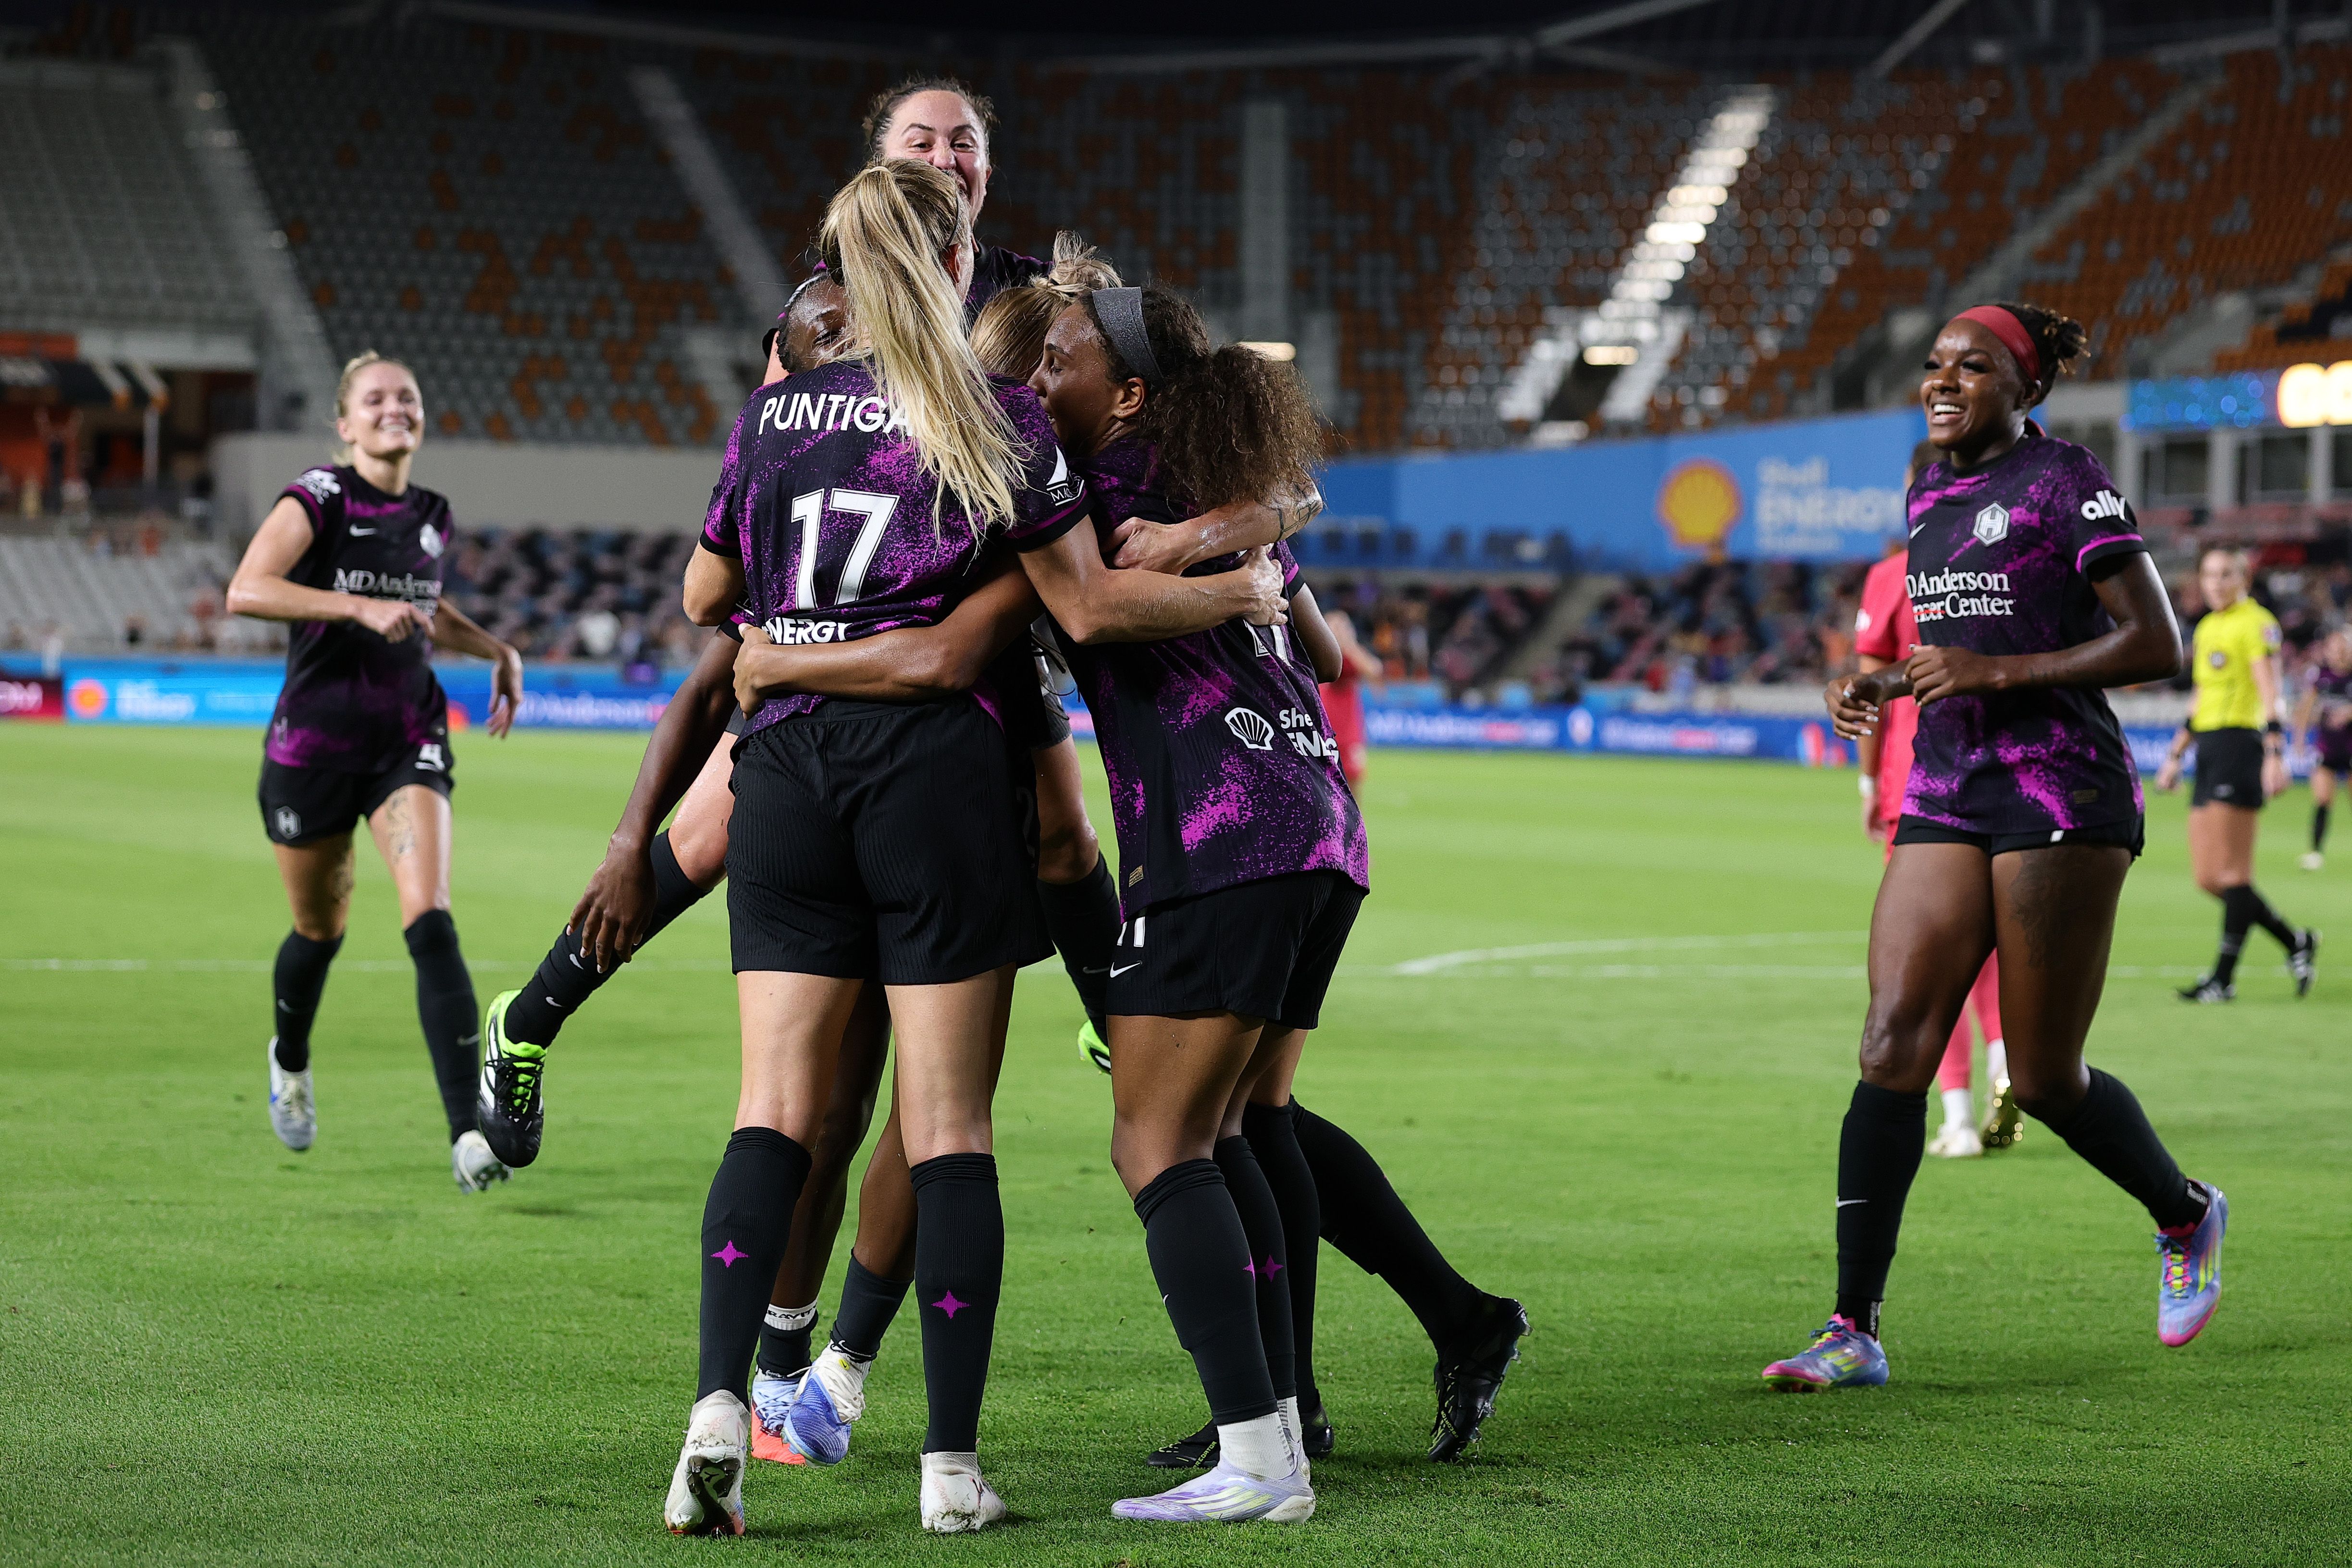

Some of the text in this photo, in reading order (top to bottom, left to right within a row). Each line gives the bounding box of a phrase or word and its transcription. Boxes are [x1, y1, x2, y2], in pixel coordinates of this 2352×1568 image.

[758, 392, 914, 436] PUNTIGA
[2080, 490, 2126, 522] ally
[791, 488, 900, 610] 17
[1905, 567, 2010, 599] DAnderson
[1945, 592, 2015, 618] Center
[1279, 707, 1313, 729] She
